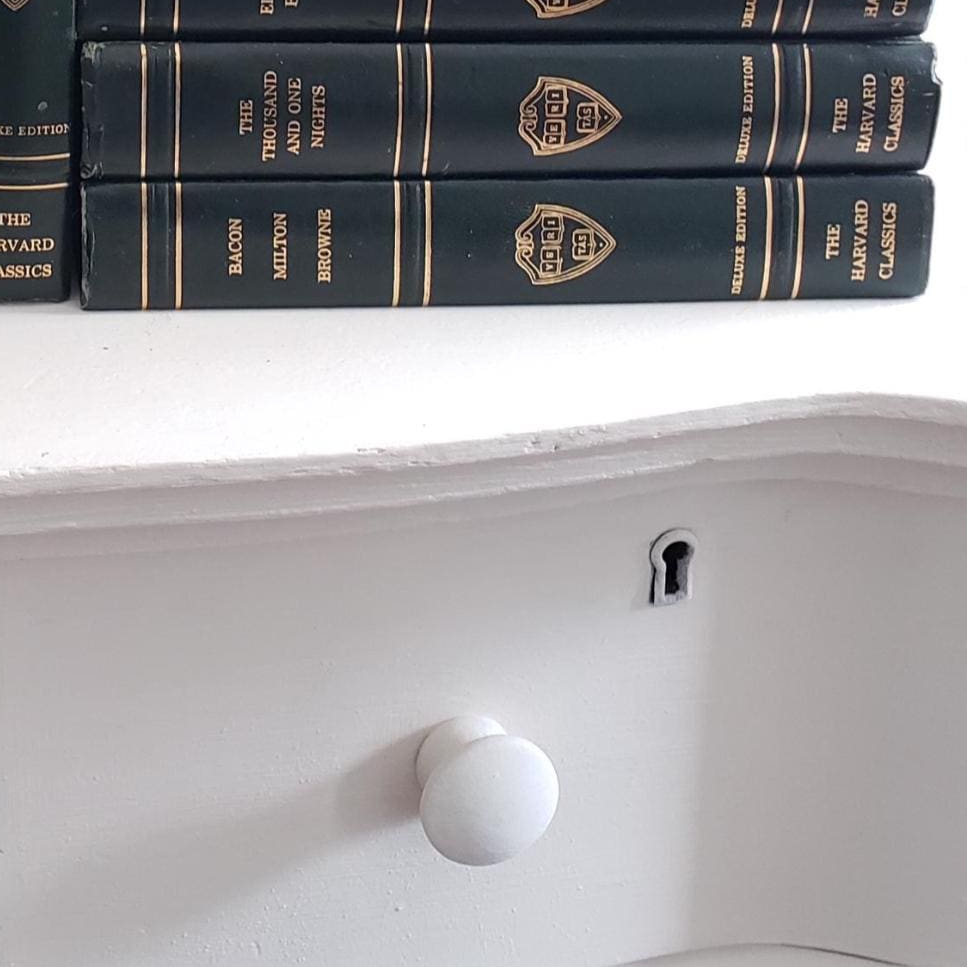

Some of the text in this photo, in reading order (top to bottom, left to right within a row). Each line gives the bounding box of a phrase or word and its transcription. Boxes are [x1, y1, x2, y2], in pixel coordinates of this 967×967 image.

[239, 99, 253, 135] THE
[262, 70, 278, 161] THOUSAND
[286, 77, 302, 156] AND ONE
[311, 85, 326, 149] NIGHTS
[735, 55, 754, 165] DELUXE EDITION
[832, 98, 849, 133] THE
[855, 73, 877, 154] HARVARD
[883, 75, 905, 153] CLASSICS
[228, 218, 242, 276] BACON
[273, 212, 287, 281] MILTON
[317, 208, 331, 284] BROWNE
[731, 185, 746, 295] DELUXE EDITION
[826, 223, 841, 259] THE
[851, 199, 869, 282] HARVARD
[878, 202, 897, 280] CLASSICS
